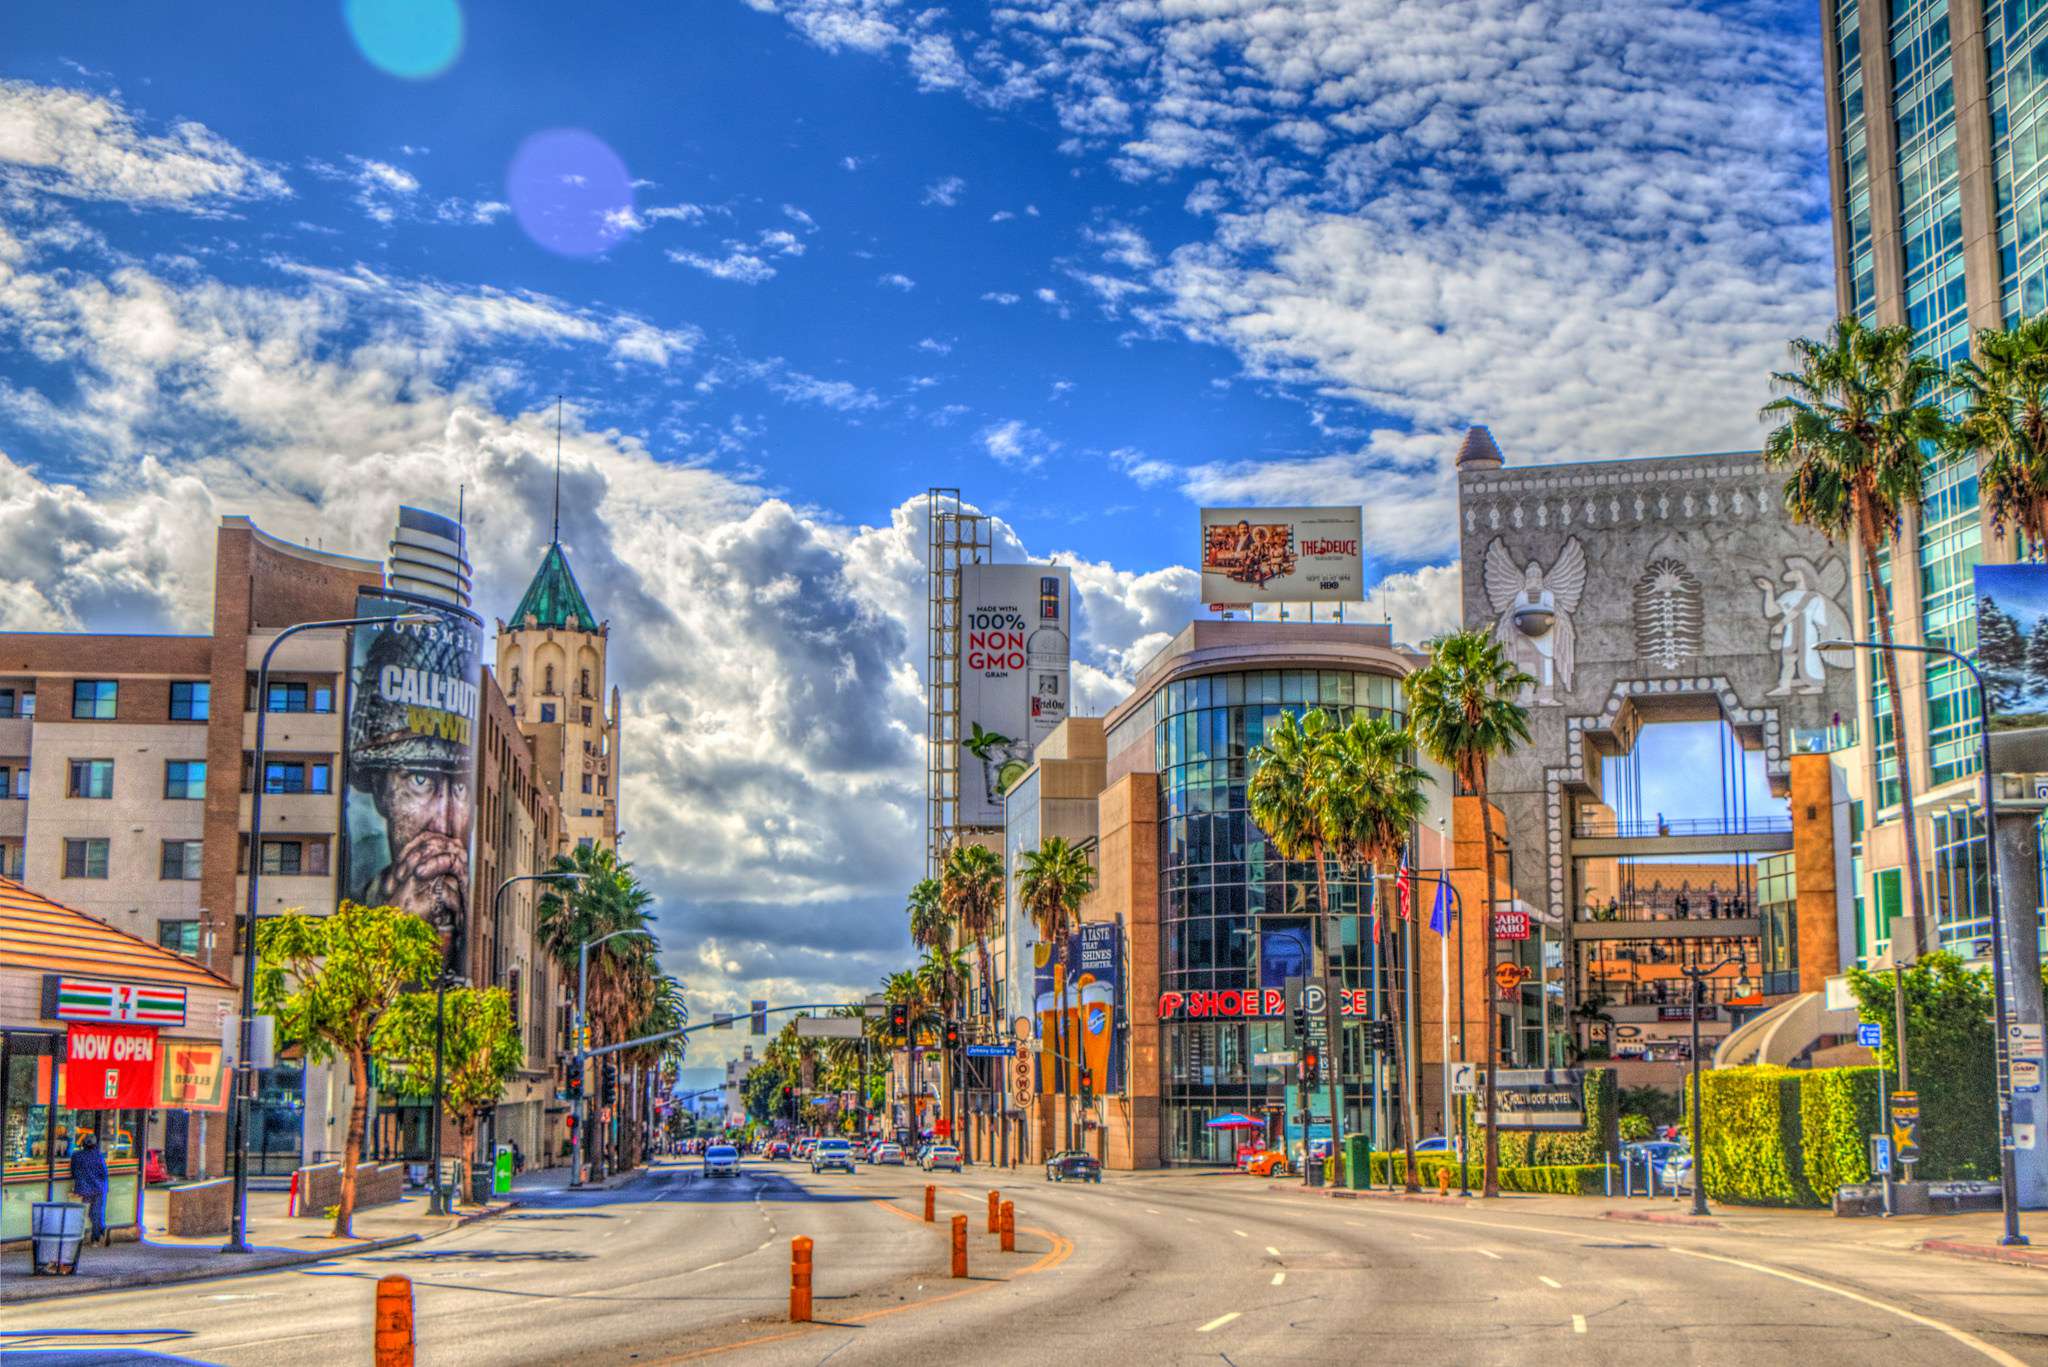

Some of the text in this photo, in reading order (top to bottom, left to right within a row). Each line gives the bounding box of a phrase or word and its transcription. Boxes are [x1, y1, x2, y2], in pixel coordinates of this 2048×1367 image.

[1301, 540, 1357, 557] THE DEUCE
[1320, 581, 1339, 590] HBO
[968, 614, 1026, 630] 100%
[970, 631, 1024, 650] NON
[968, 652, 1025, 670] GMO
[381, 664, 442, 709] CALL
[407, 704, 472, 746] WWII
[1082, 928, 1110, 941] A TASTE
[1082, 942, 1099, 950] THAT
[1082, 950, 1112, 960] SHINES
[1188, 990, 1259, 1016] SHOE
[1264, 989, 1367, 1015] PCE
[72, 1034, 154, 1062] NOW OPEN
[1549, 1092, 1571, 1104] HOTEL
